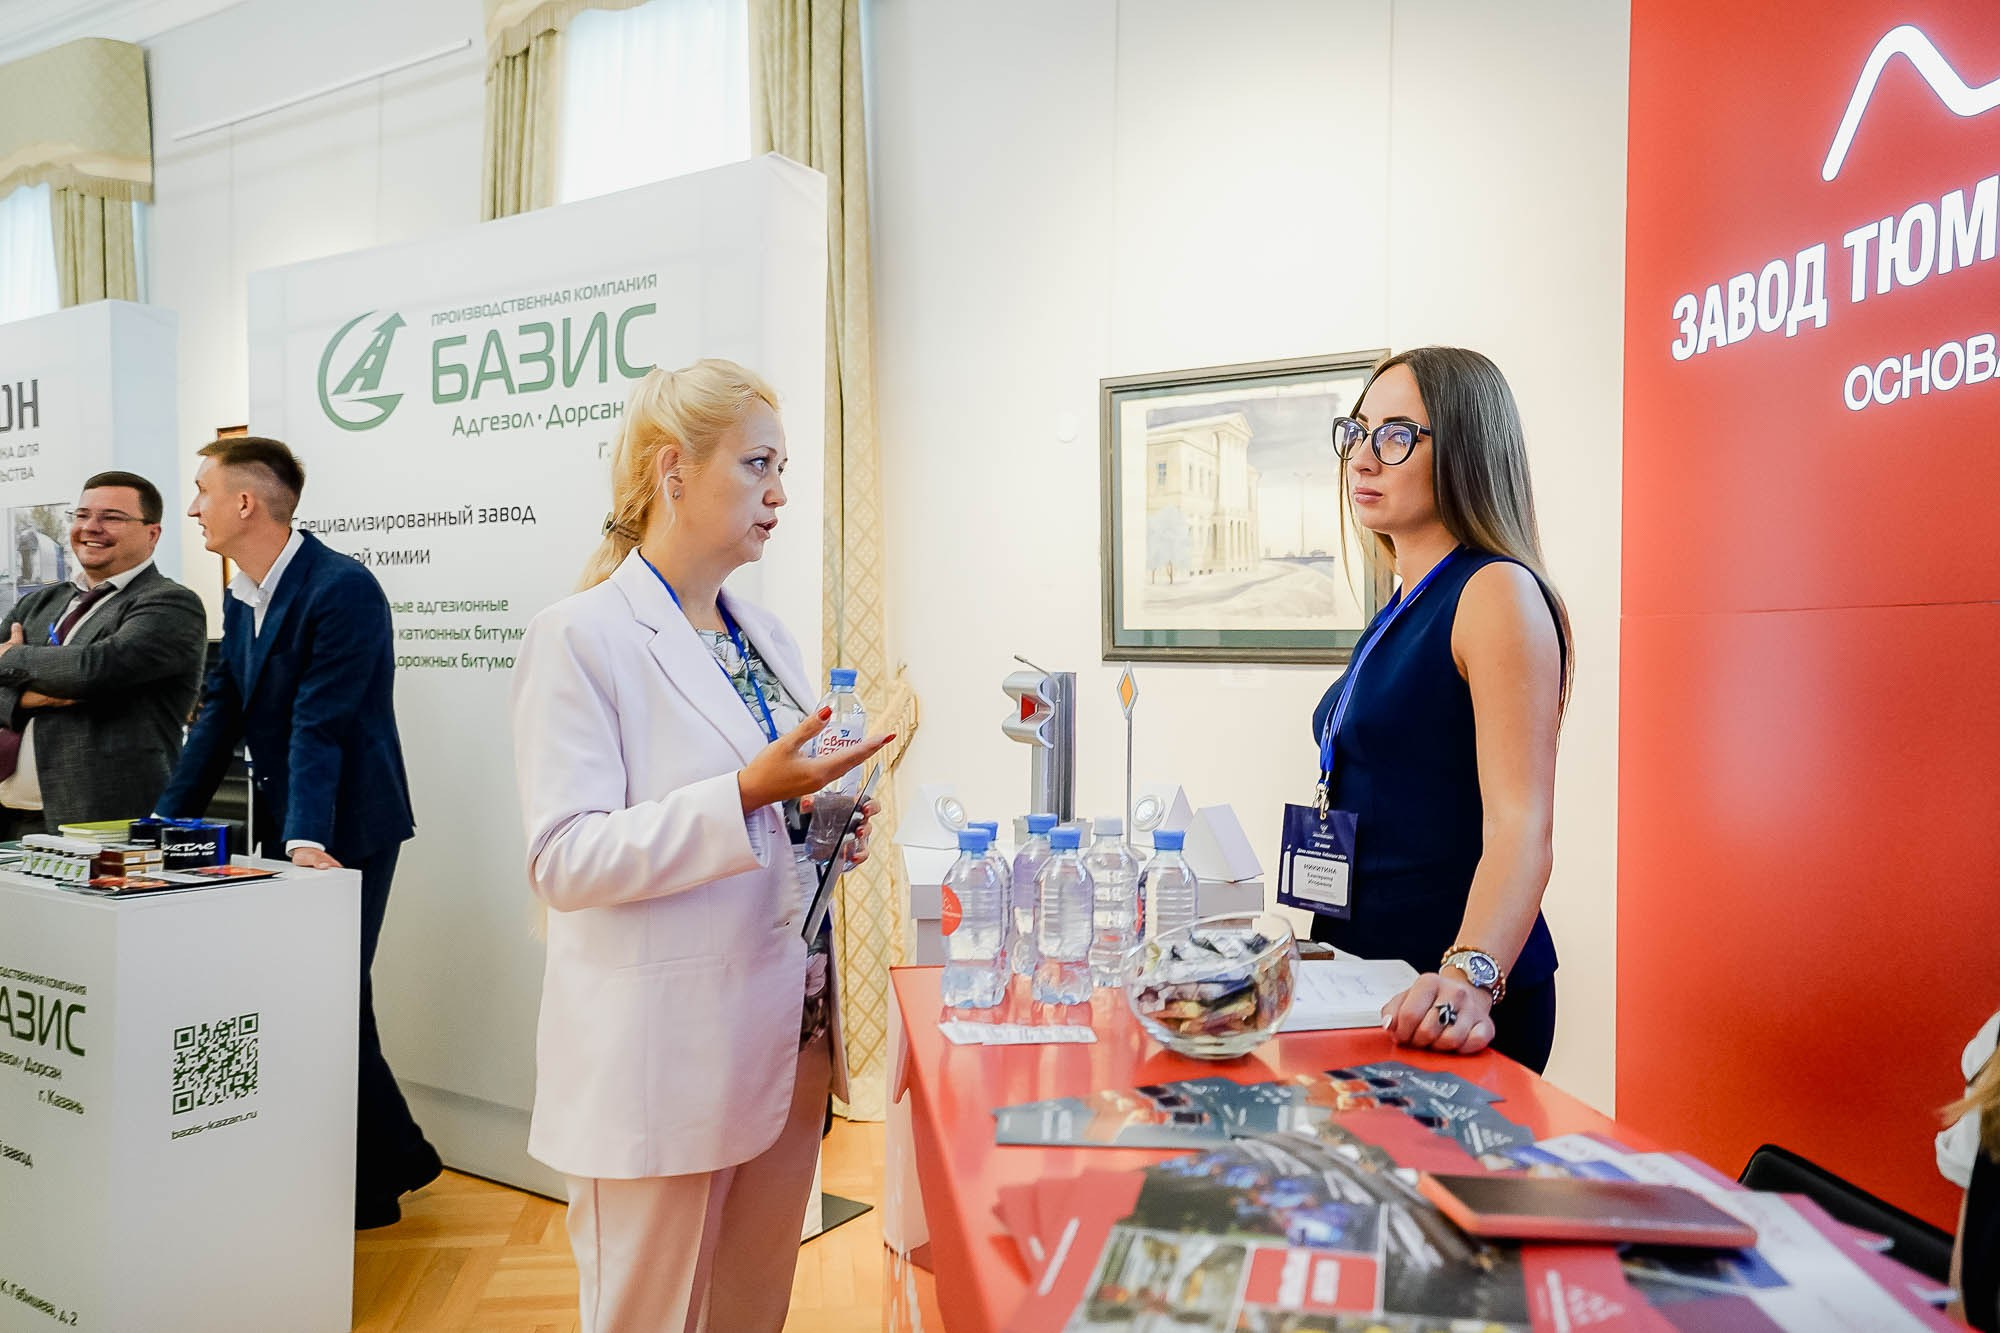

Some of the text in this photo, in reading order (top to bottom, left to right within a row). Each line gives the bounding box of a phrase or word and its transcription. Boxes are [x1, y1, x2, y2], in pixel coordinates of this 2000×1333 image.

[1671, 174, 2000, 361] ЗАВОД ТЮМ
[431, 273, 657, 327] ПРОИЗВОДСТВЕННАЯ КОМПАНИЯ
[432, 302, 657, 405] БАЗИС
[1843, 333, 2000, 411] ОСНОВ
[478, 505, 537, 525] завод
[350, 547, 430, 567] ой химии
[417, 598, 509, 616] адгезионные
[398, 627, 471, 641] катионных
[394, 653, 517, 673] орожных битумо
[0, 986, 86, 1057] АЗИС
[171, 1111, 258, 1141] bazis-kazan.ru
